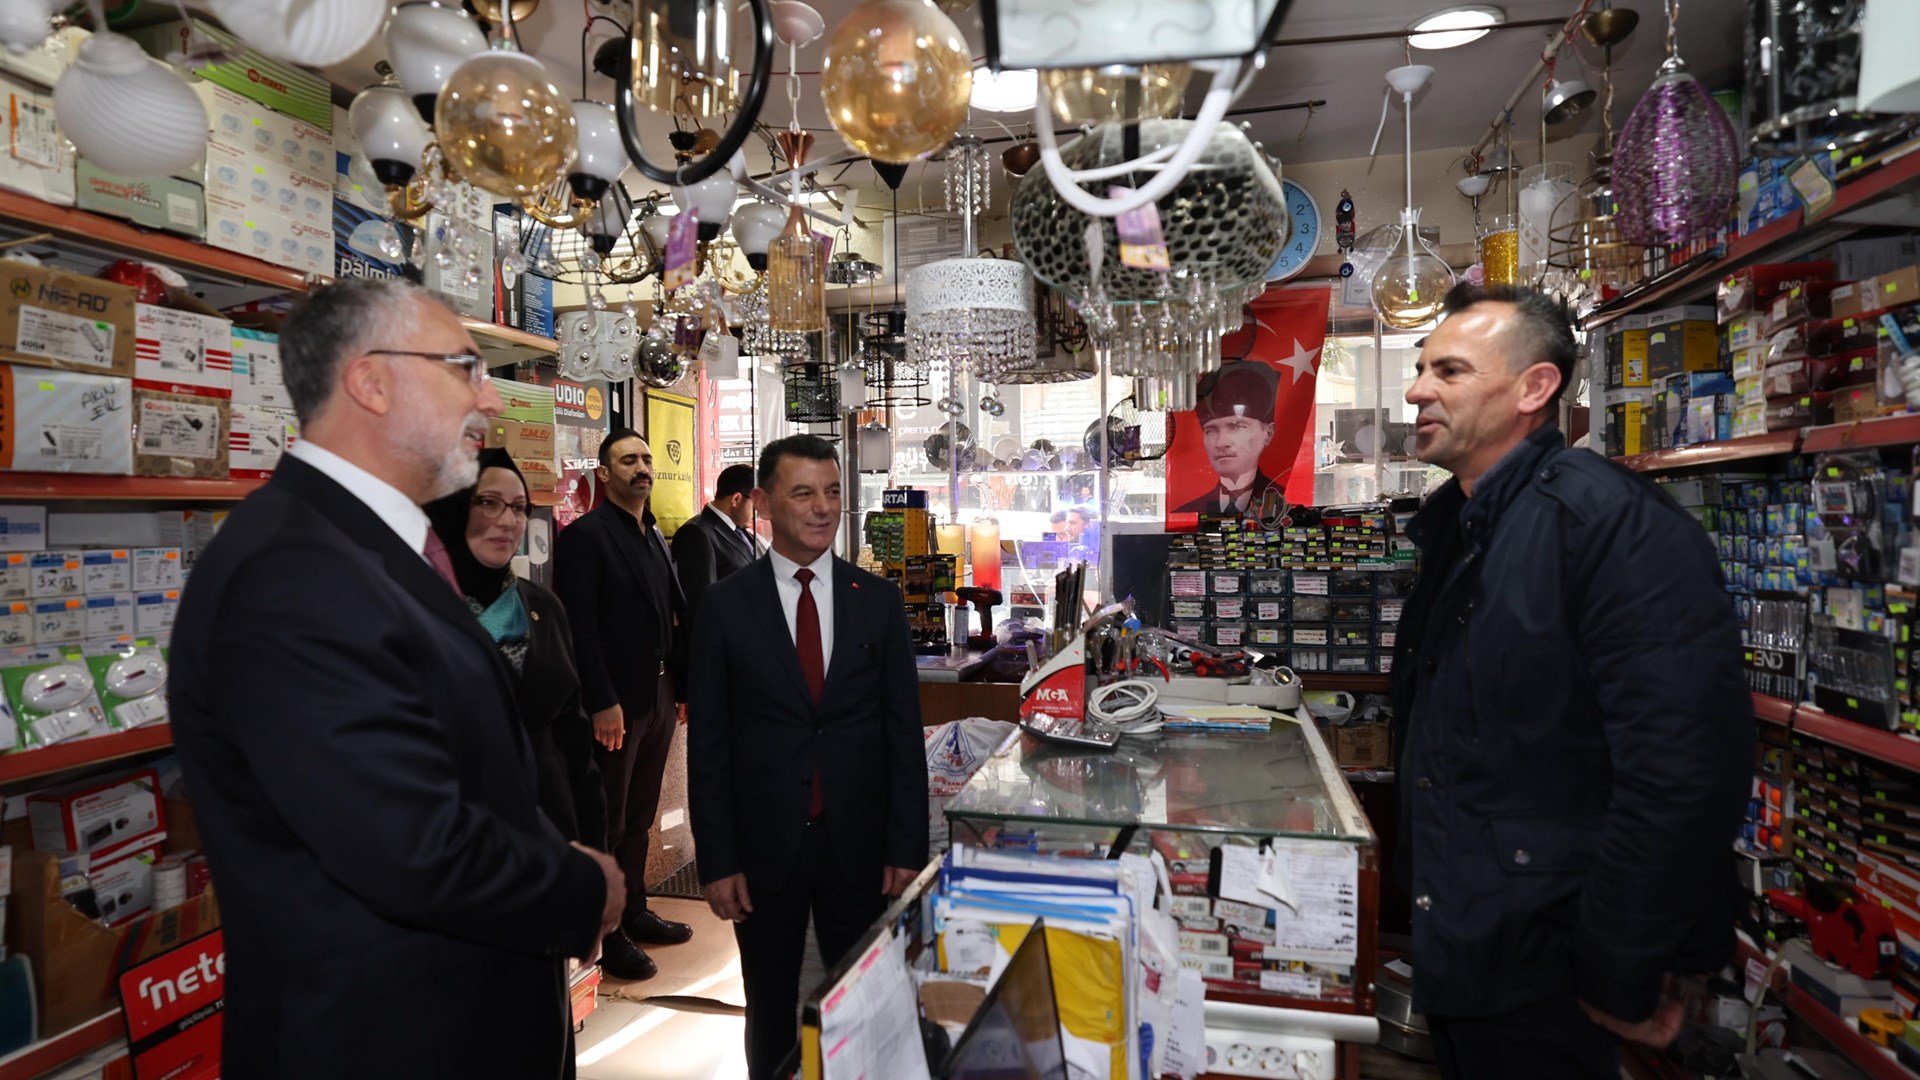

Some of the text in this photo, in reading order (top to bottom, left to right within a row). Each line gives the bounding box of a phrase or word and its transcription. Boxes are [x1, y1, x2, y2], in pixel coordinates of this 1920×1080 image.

[1284, 190, 1290, 201] 1
[1296, 203, 1305, 216] 2
[1301, 223, 1310, 235] 3
[1295, 242, 1304, 253] 4
[1280, 256, 1289, 268] 5
[556, 384, 585, 406] UDIO
[1753, 650, 1783, 670] END
[1036, 688, 1069, 701] MGA
